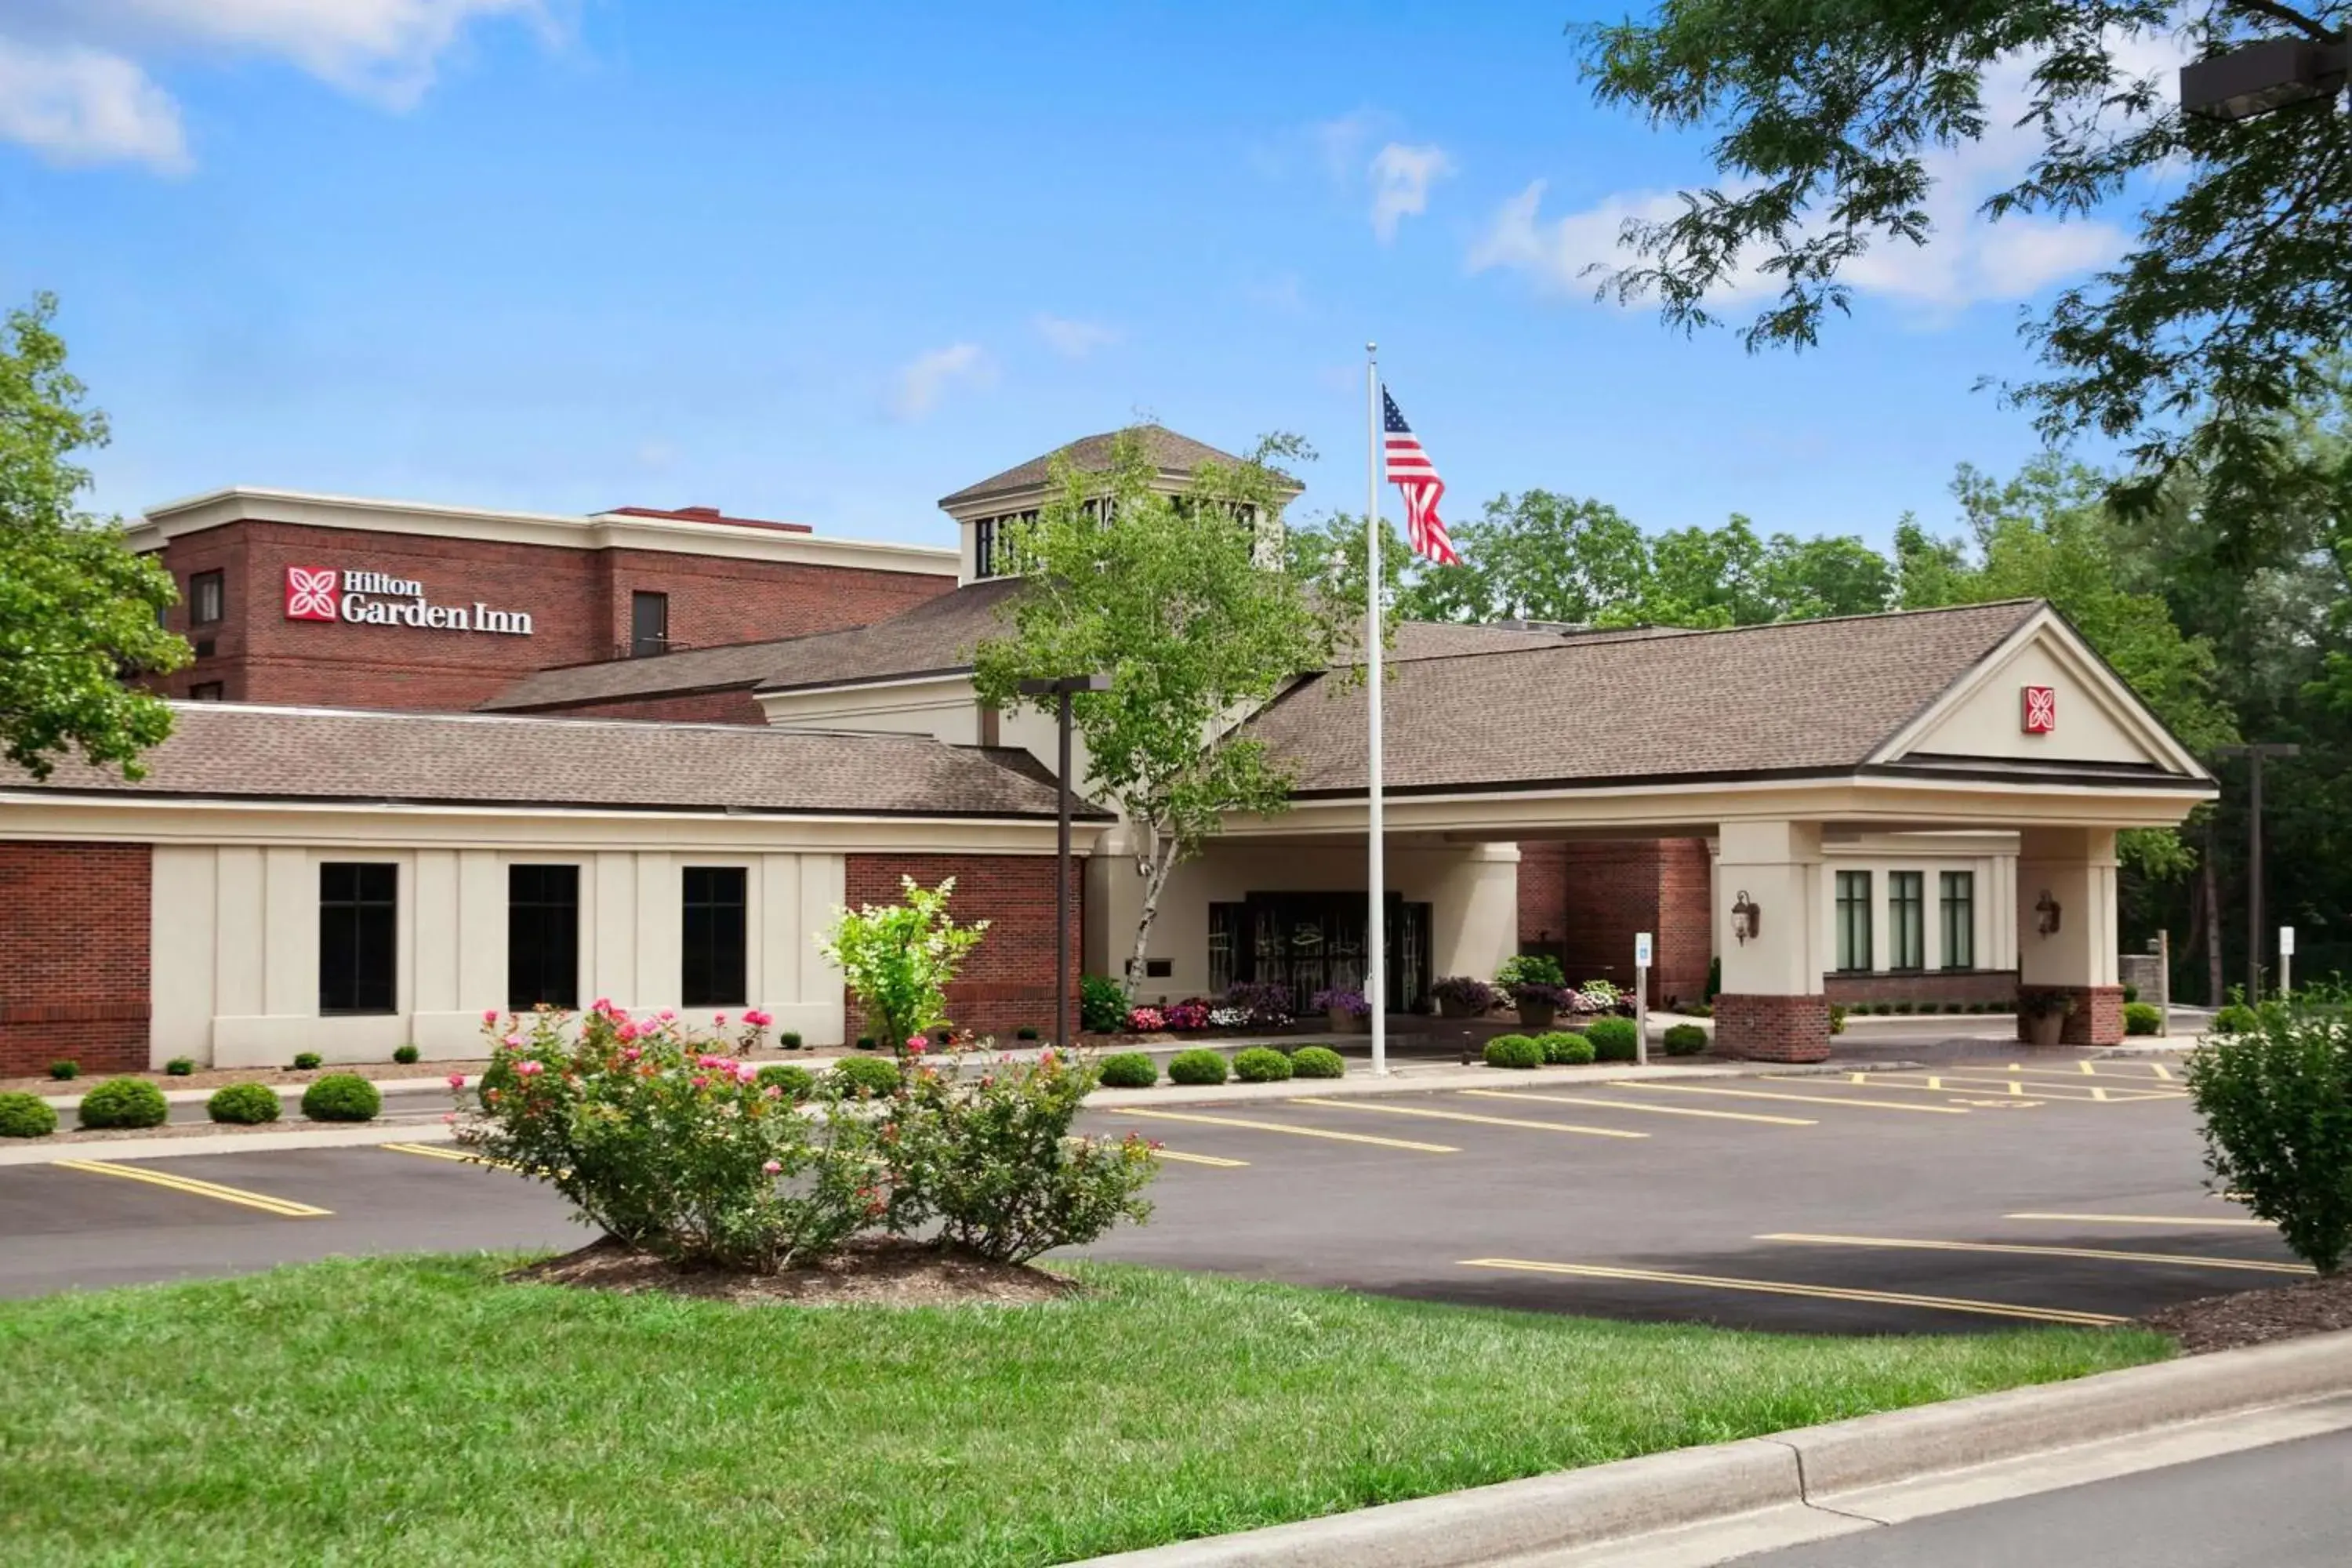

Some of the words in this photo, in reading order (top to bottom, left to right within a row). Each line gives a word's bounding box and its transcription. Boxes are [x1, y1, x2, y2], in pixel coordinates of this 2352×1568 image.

[343, 570, 423, 597] Hilton
[341, 593, 471, 630] Garden
[473, 602, 534, 634] Inn
